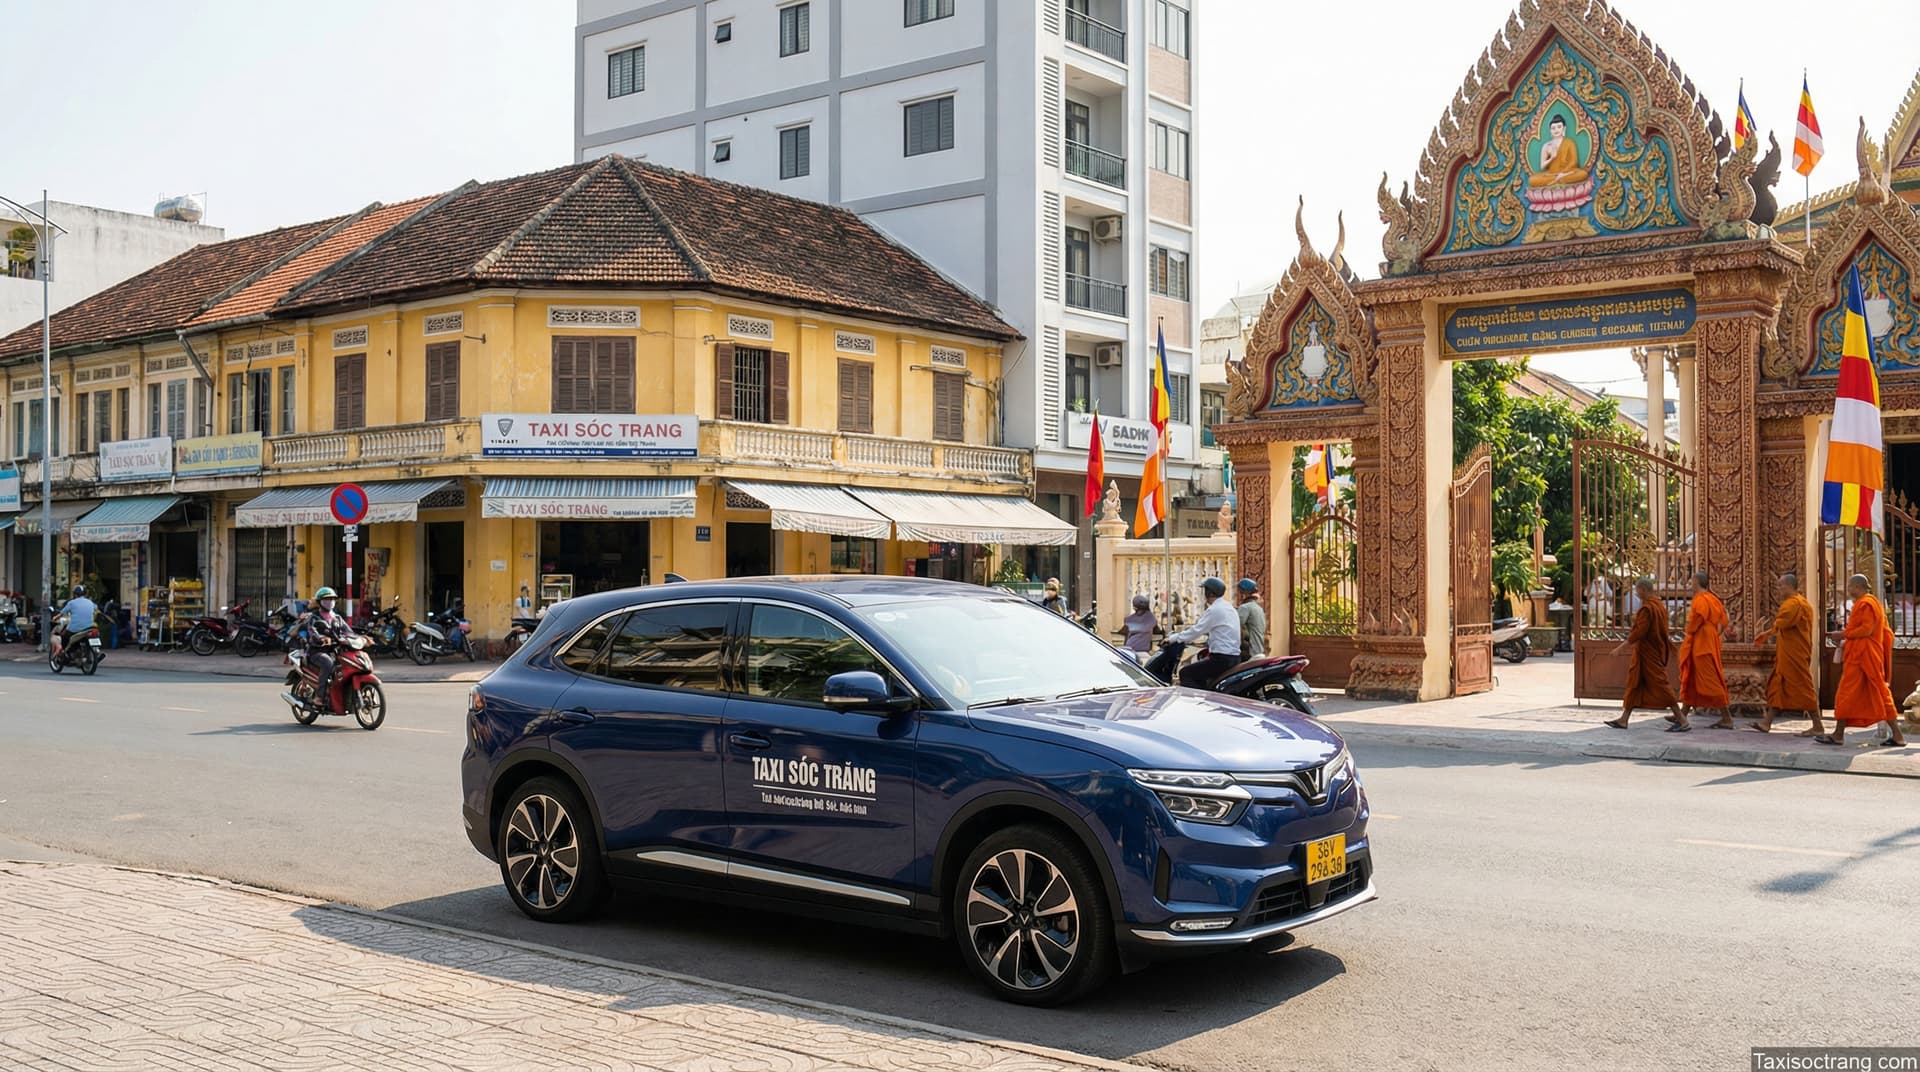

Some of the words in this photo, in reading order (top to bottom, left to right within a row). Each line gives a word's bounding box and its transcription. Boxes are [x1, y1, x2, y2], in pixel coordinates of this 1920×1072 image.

[528, 423, 568, 437] TAXI
[575, 419, 613, 438] SÓC
[619, 423, 682, 438] TRANG
[510, 504, 536, 515] TAXI
[752, 757, 784, 783] TAXI
[788, 755, 819, 787] SÓC
[823, 761, 876, 794] TRĂNG
